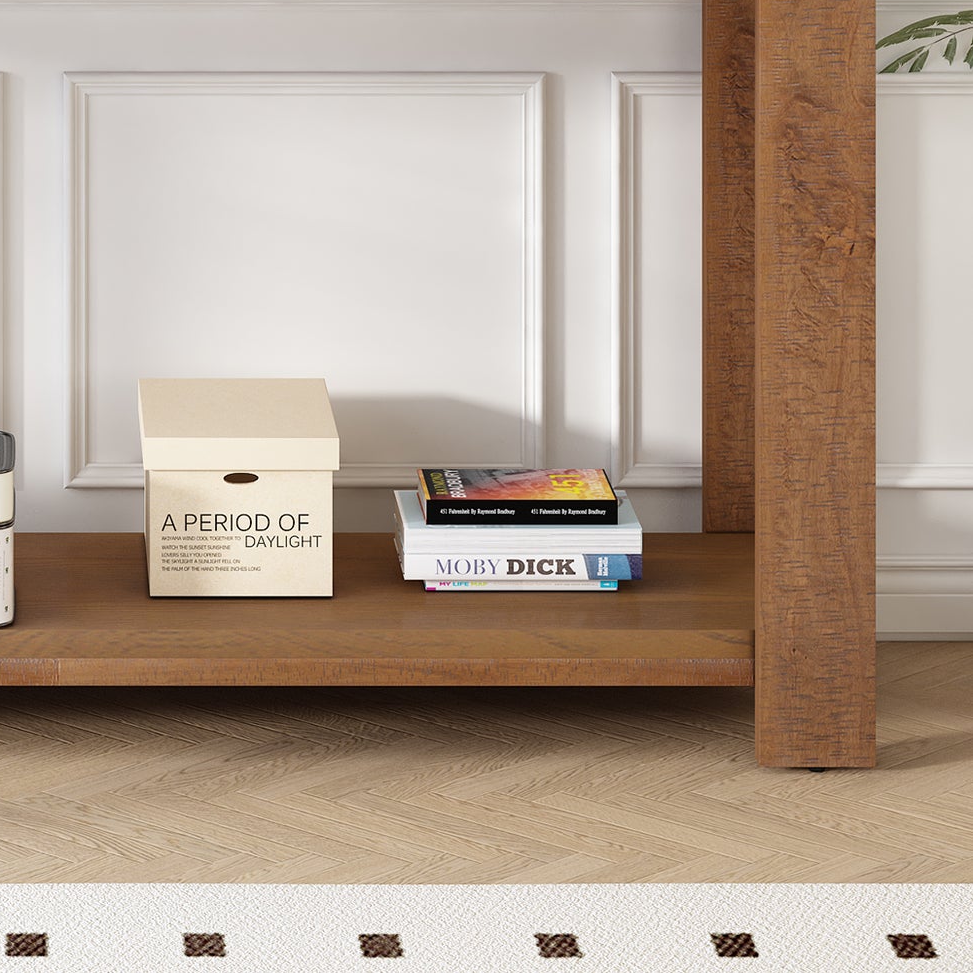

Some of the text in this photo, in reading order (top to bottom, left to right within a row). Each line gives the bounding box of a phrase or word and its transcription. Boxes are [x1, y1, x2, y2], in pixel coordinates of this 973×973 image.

[443, 468, 467, 498] BRADBURY
[548, 474, 585, 494] 451
[477, 508, 497, 516] Raymond
[568, 508, 587, 516] Raymond
[161, 513, 309, 532] A PERIOD OF
[245, 535, 322, 548] DAYLIGHT
[435, 558, 577, 576] MOBY DICK
